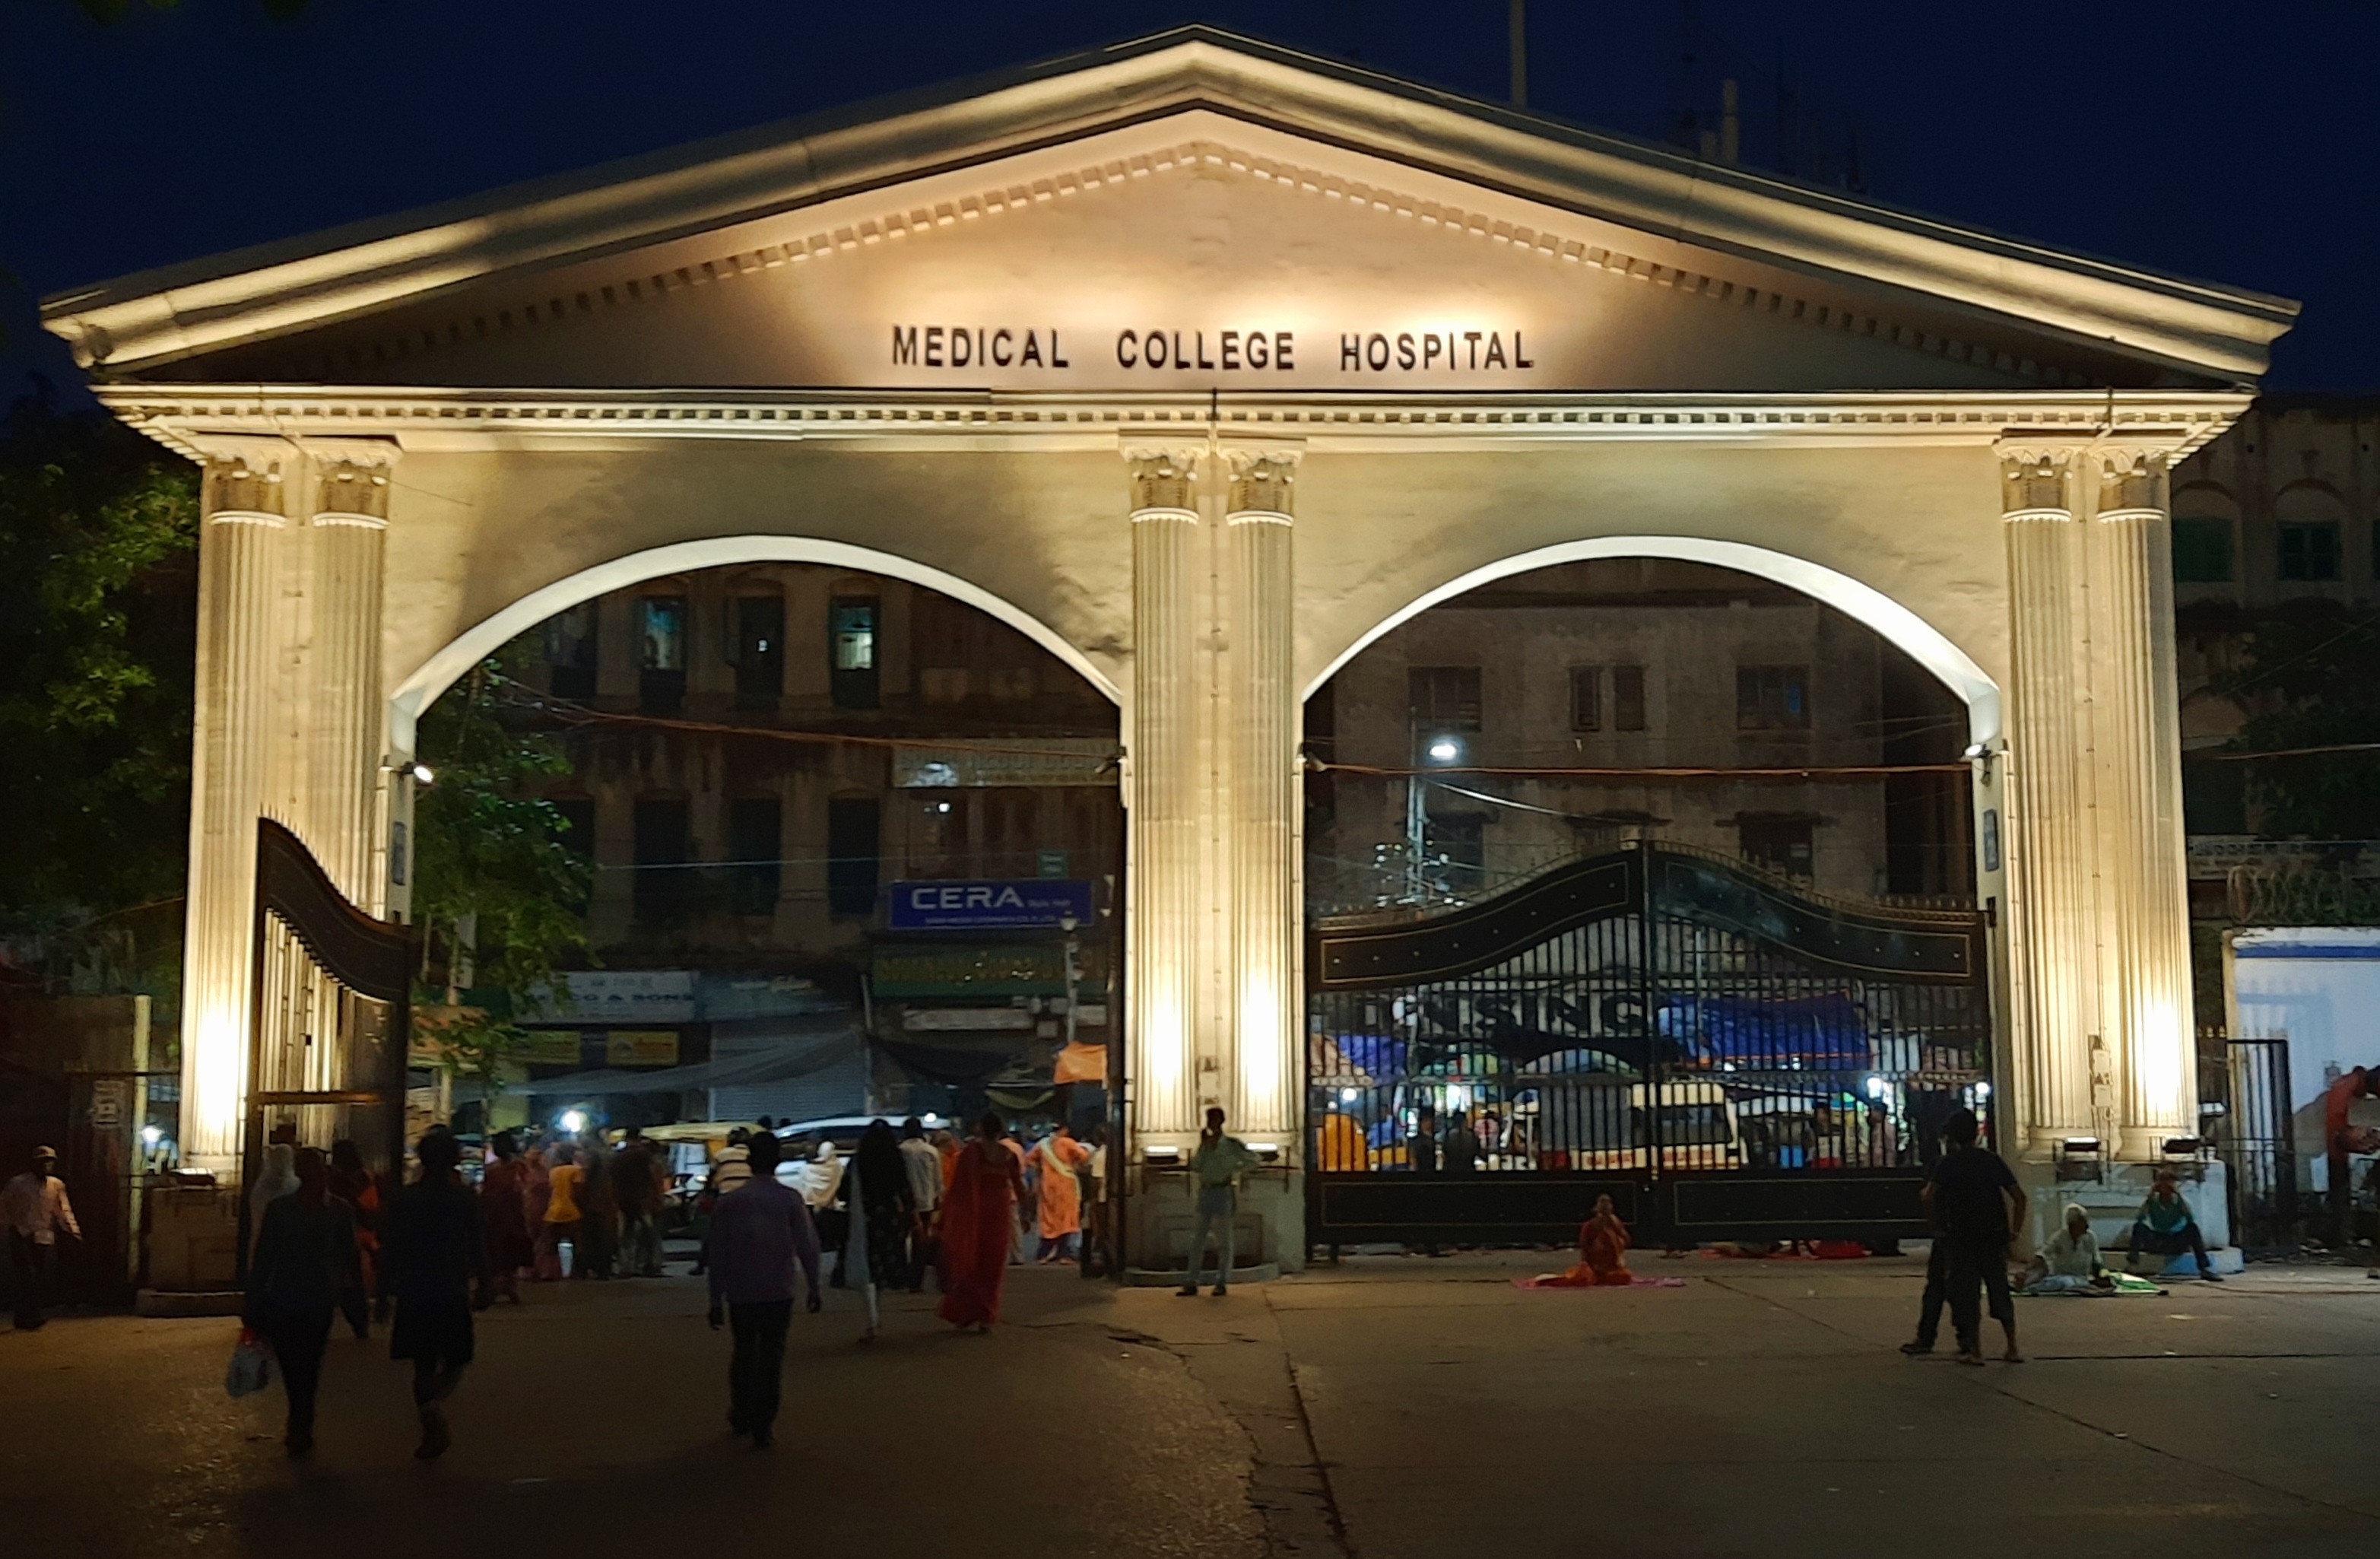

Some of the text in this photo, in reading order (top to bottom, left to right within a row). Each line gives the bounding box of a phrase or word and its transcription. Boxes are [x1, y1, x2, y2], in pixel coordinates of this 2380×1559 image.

[893, 326, 1534, 372] MEDICAL COLLEGE HOSPITAL
[911, 886, 1025, 910] CERA
